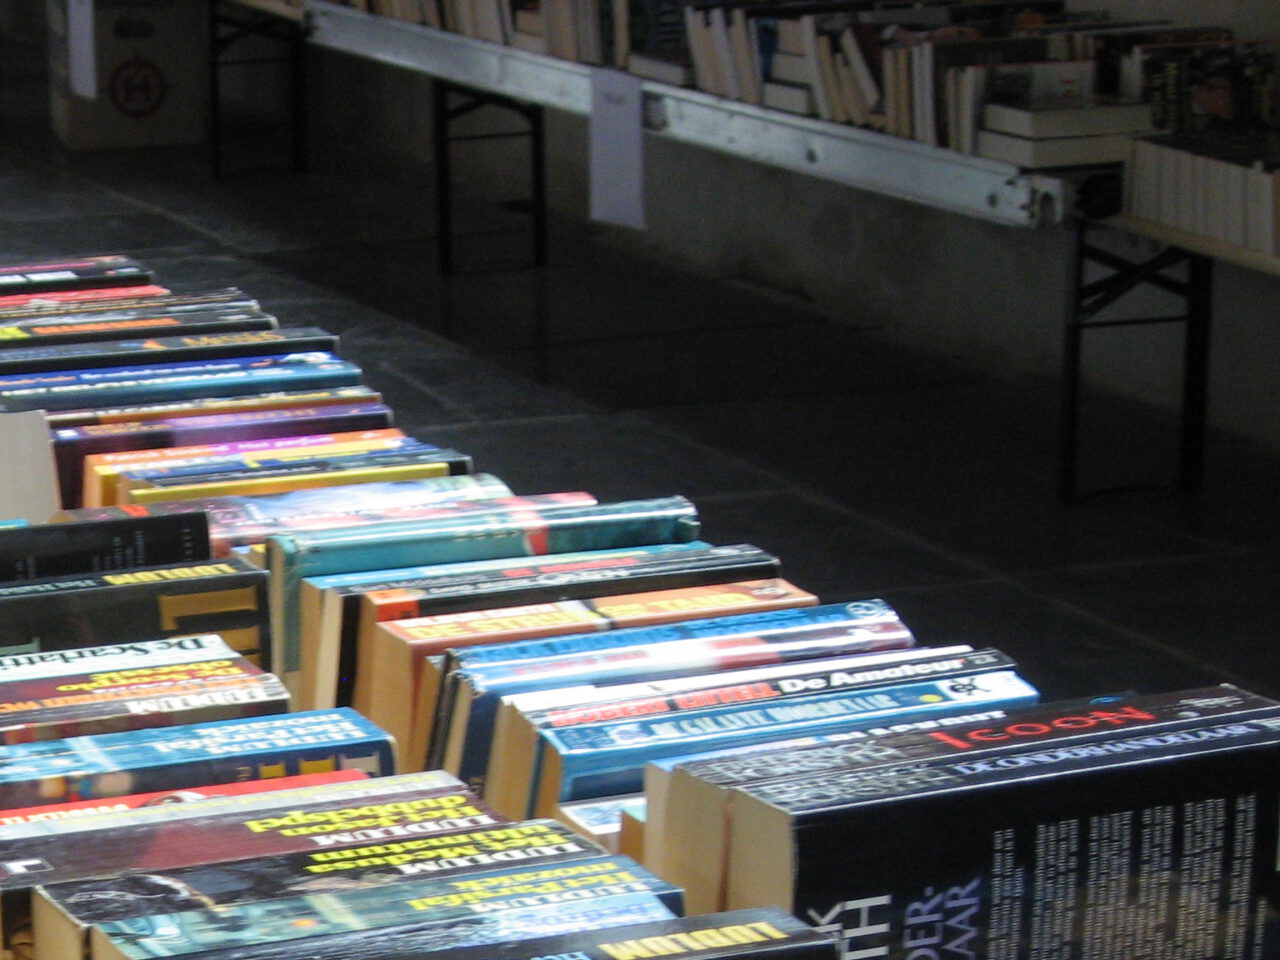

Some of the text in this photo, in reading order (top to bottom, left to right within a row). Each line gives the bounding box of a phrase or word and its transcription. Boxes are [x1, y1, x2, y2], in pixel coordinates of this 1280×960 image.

[101, 563, 240, 585] LUDLUM
[157, 636, 209, 652] De
[405, 625, 465, 640] DE
[56, 667, 244, 692] De Scorpio
[88, 660, 234, 681] obsessie
[777, 673, 827, 693] De
[828, 657, 966, 686] Amateur
[153, 720, 359, 754] Het Parsifal
[203, 730, 371, 755] LUDLUM
[986, 723, 1263, 772] ONDERHANDELAAR
[241, 792, 468, 833] dubbelspel
[278, 804, 484, 839] Het Jason
[307, 813, 497, 847] LUDLUM
[307, 825, 553, 865] ultimatum
[303, 832, 568, 875] Het Medusa
[395, 842, 584, 876] LUDLUM
[404, 871, 640, 912] Het Parsifal
[468, 882, 652, 914] LUDLUM
